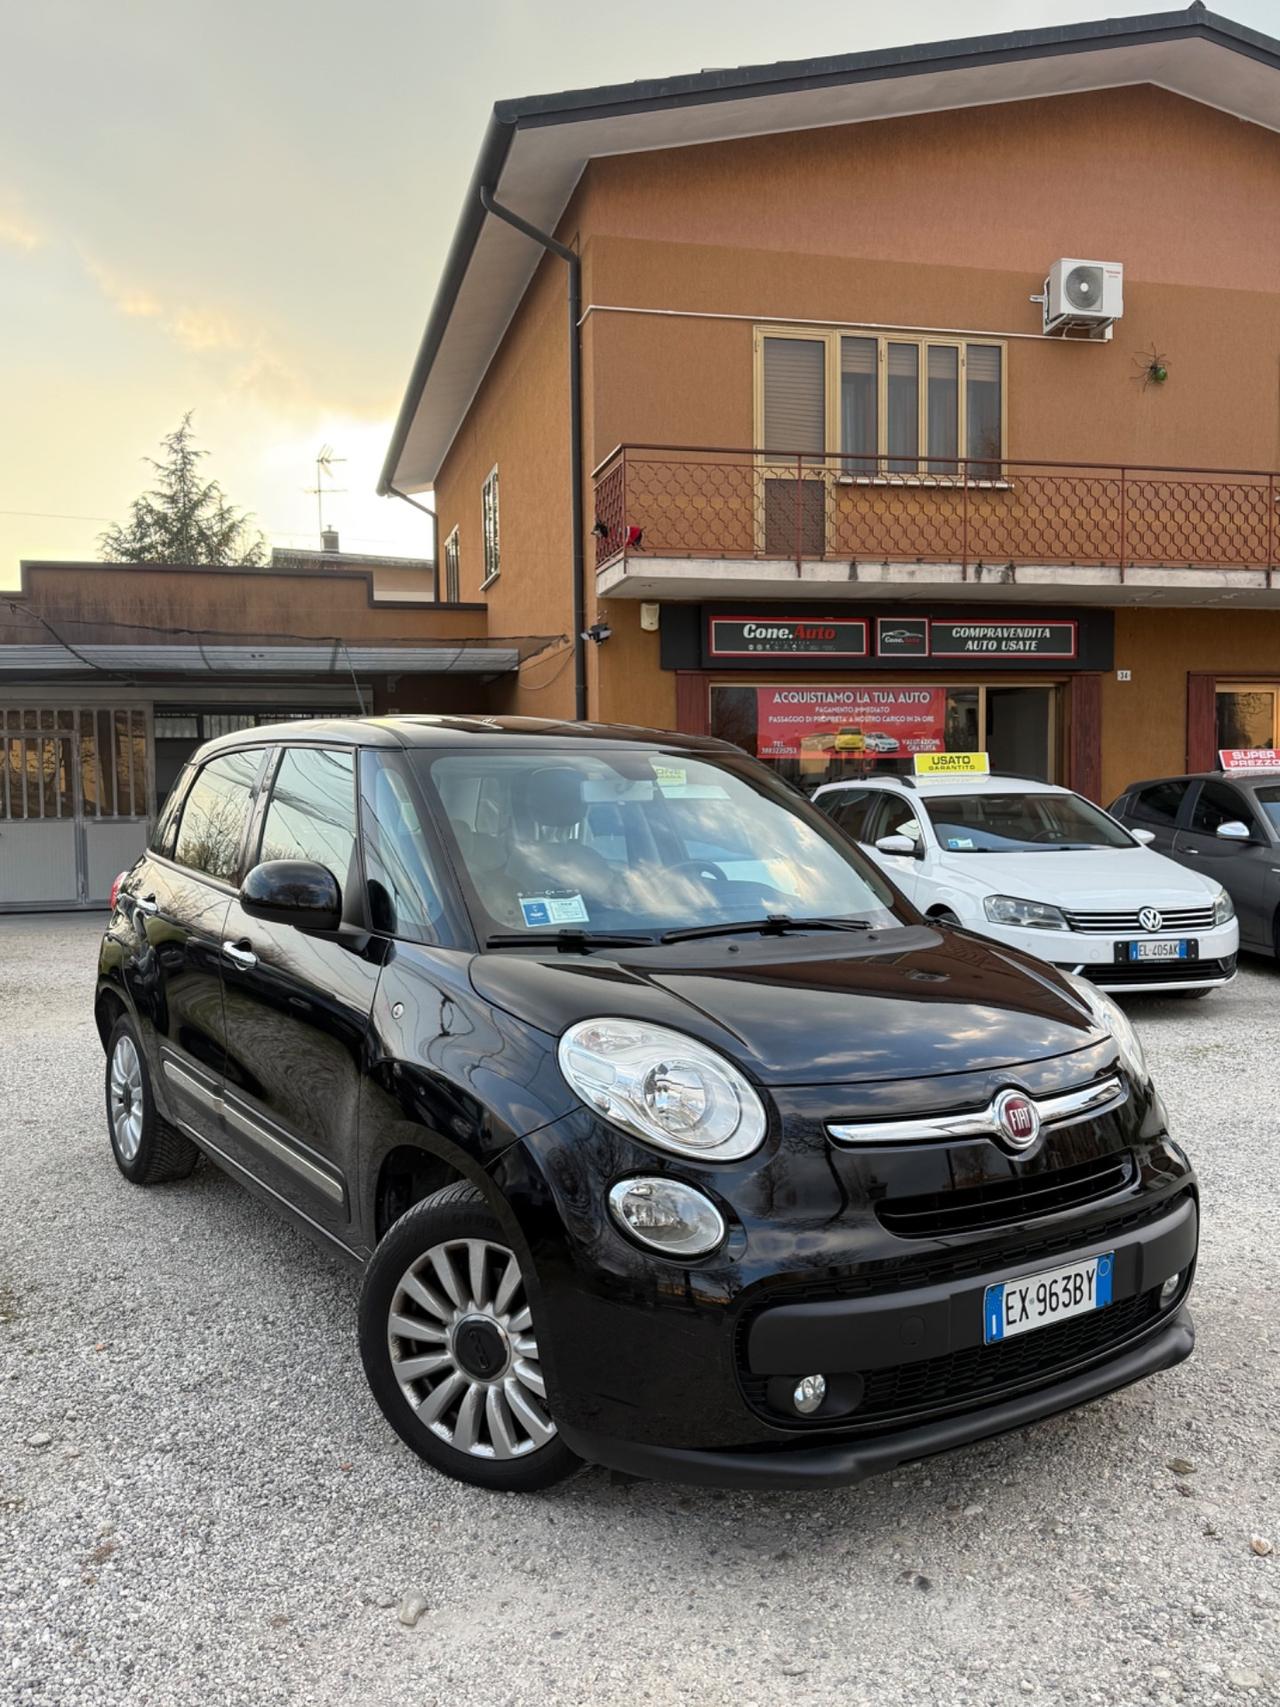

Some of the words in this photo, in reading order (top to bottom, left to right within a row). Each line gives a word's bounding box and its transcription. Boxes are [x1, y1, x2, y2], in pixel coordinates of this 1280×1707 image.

[952, 627, 1051, 639] COMPRAVENDITA
[965, 640, 997, 651] AUTO
[1001, 640, 1038, 651] USATE
[773, 692, 853, 703] ACQUISTIAMO
[856, 692, 872, 704] LA
[873, 692, 896, 704] TUA
[898, 692, 930, 704] AUTO
[815, 706, 854, 714] PAGAMENTO
[768, 715, 805, 723] PASSAGGIO
[931, 755, 971, 765] USATO
[1231, 750, 1276, 760] SUPER
[1230, 759, 1280, 767] PREZZO
[1139, 944, 1149, 956] EL
[1152, 943, 1179, 956] 405AK
[1009, 1107, 1031, 1131] FIAT
[1005, 1287, 1029, 1326] EX
[1036, 1268, 1096, 1317] 963BY
